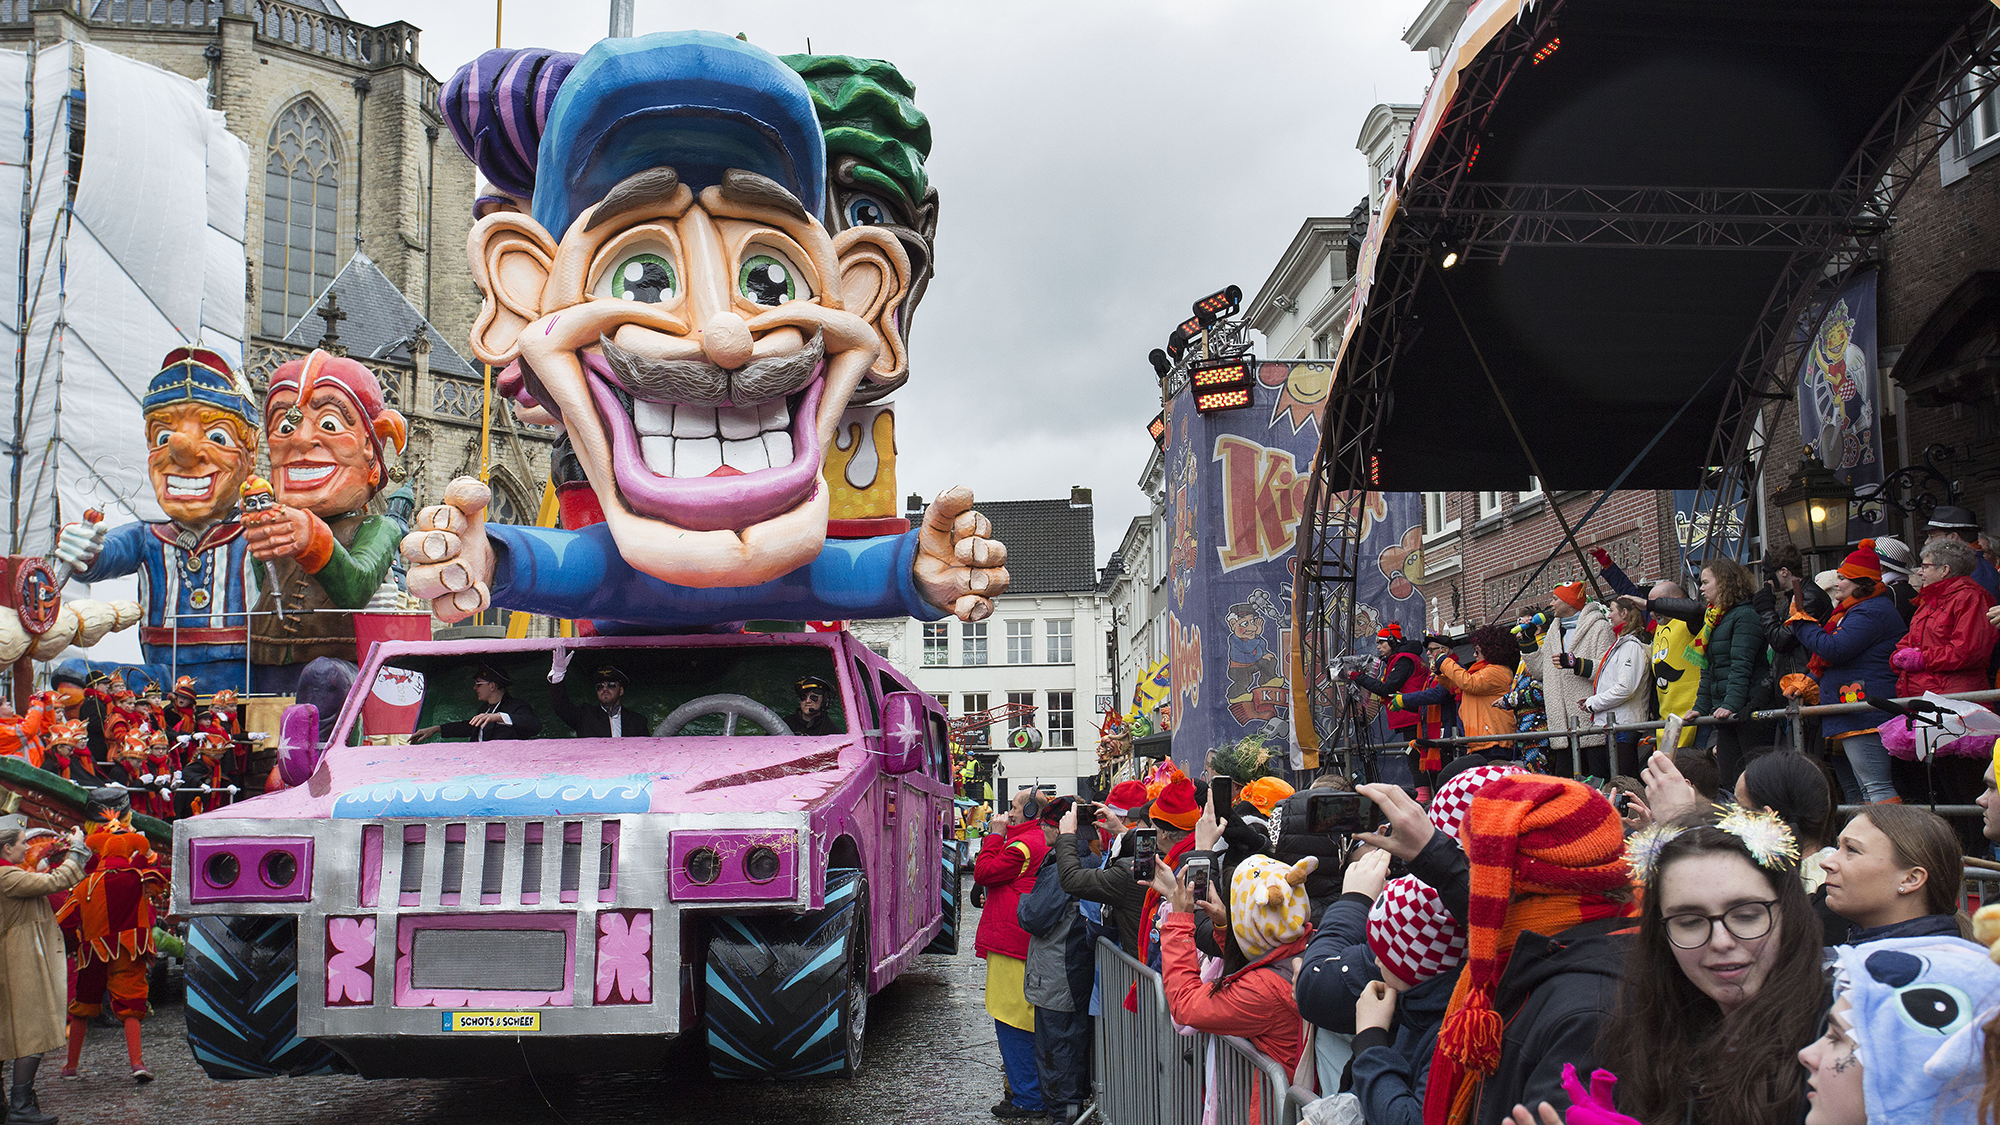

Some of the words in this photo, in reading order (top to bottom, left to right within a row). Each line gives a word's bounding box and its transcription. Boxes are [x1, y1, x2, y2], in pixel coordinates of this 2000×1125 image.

[1214, 435, 1387, 573] Kielet
[1489, 562, 1560, 609] DICKENS
[1564, 561, 1575, 580] &
[460, 1016, 494, 1027] SCHOTS
[502, 1016, 535, 1027] SCHEEF
